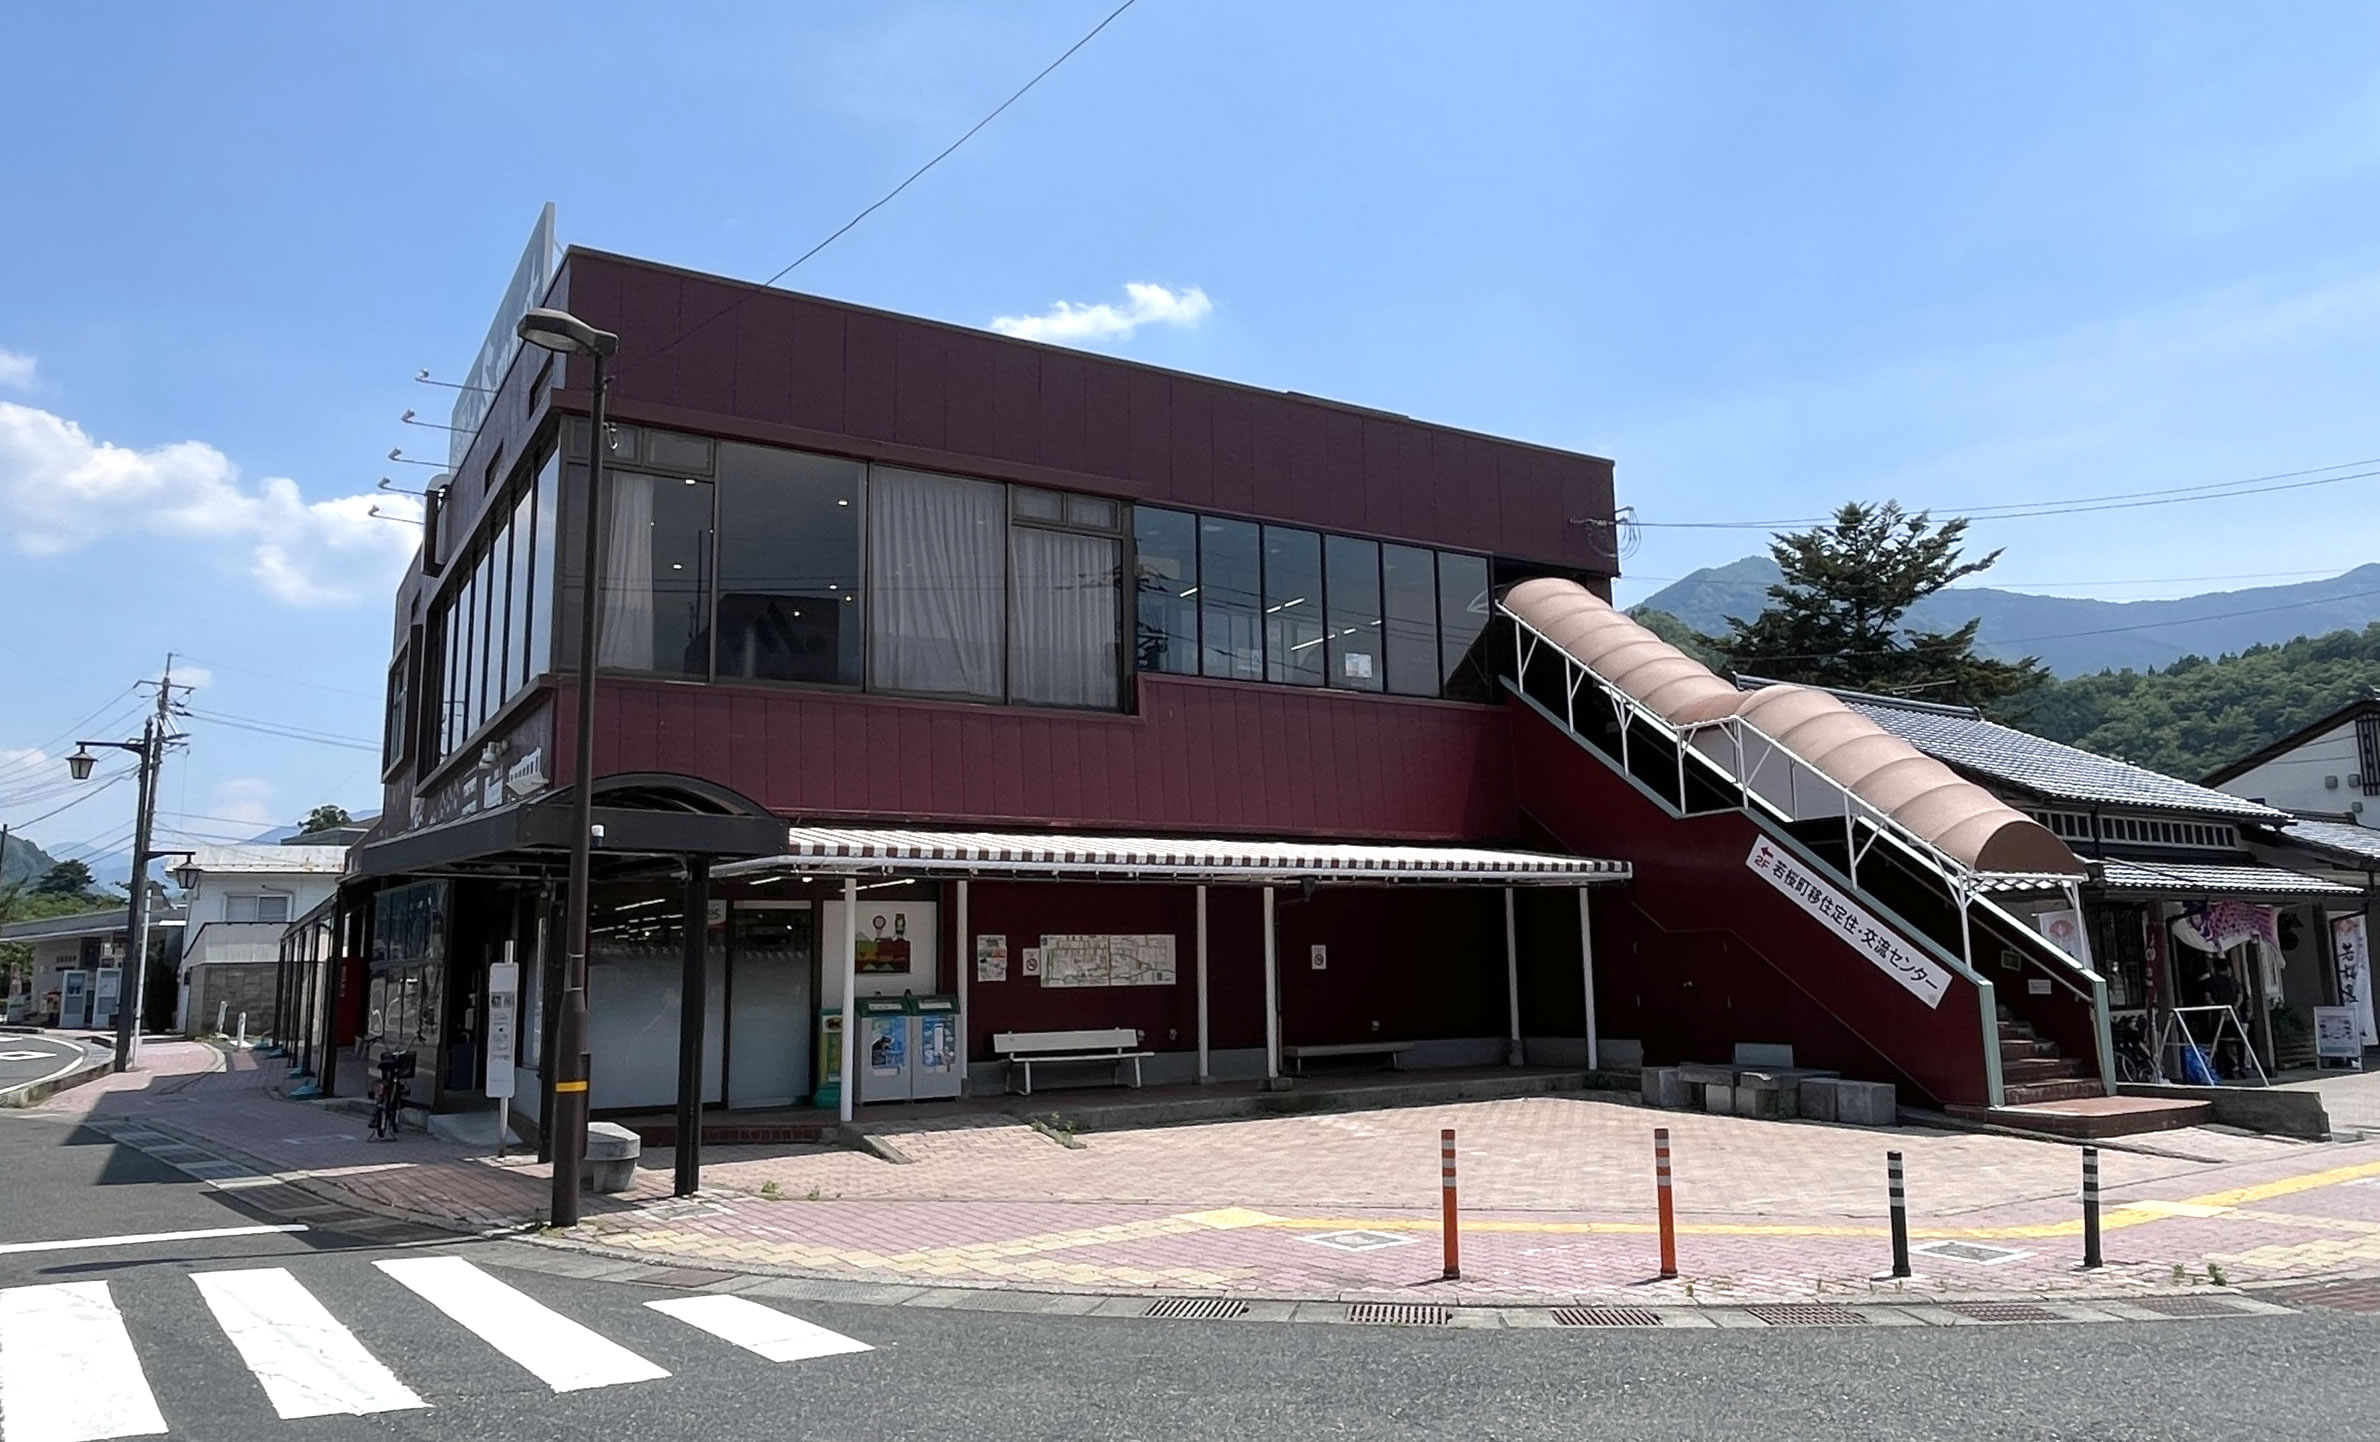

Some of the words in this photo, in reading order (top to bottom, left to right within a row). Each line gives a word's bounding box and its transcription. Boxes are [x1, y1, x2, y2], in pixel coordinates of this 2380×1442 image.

[1754, 855, 1771, 869] 2F
[1772, 859, 1938, 990] 若桜町移住定住・交流センター
